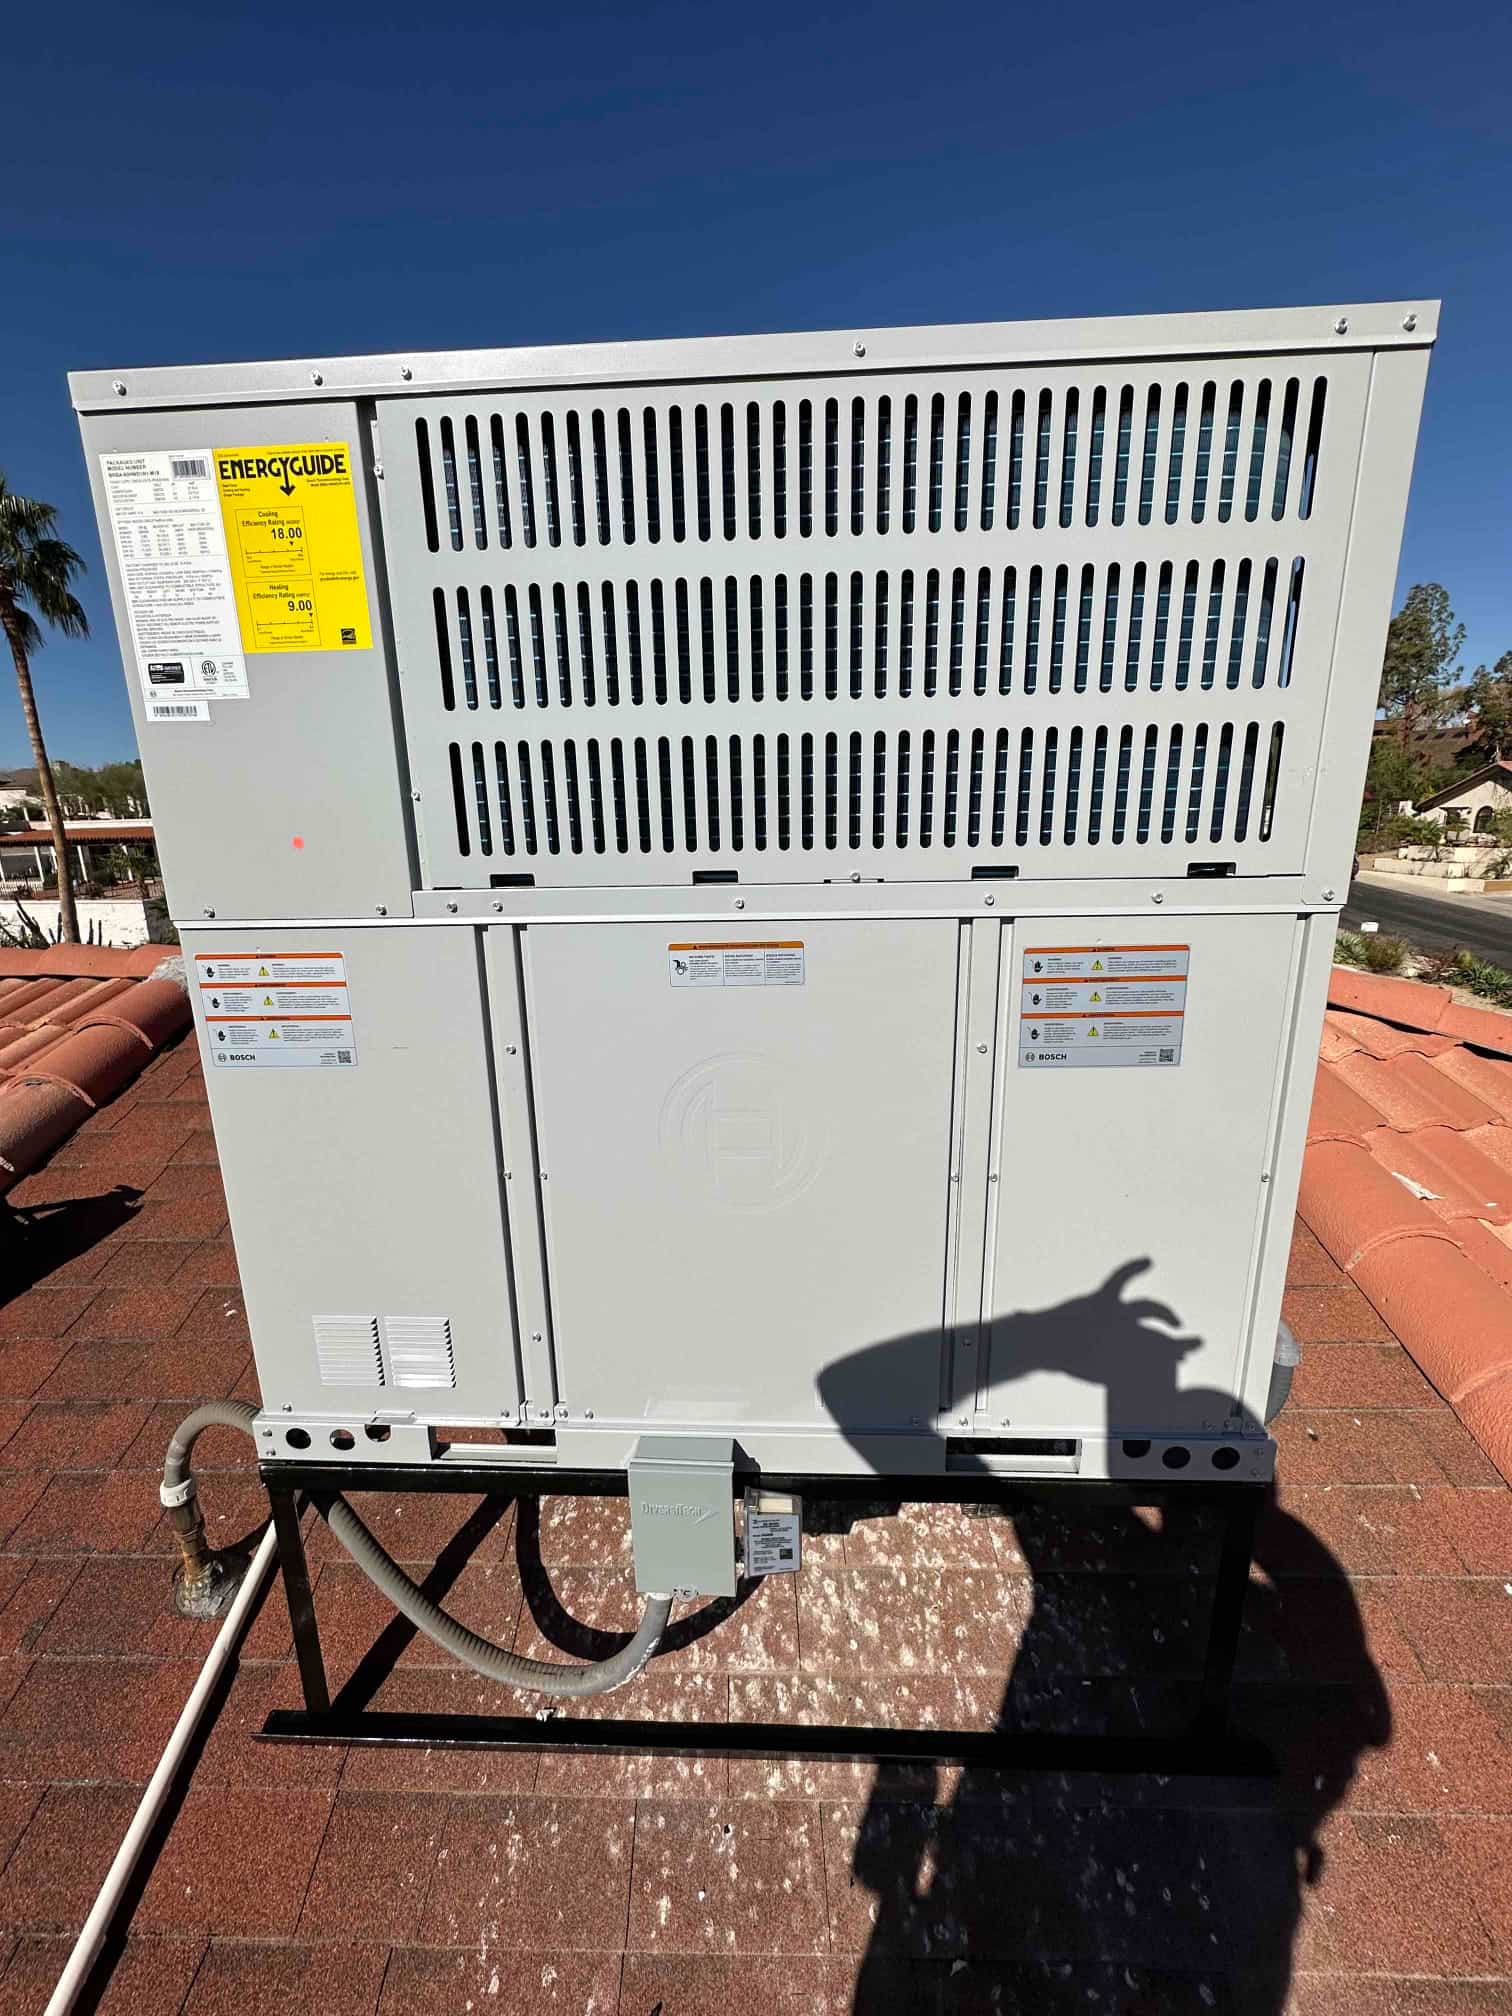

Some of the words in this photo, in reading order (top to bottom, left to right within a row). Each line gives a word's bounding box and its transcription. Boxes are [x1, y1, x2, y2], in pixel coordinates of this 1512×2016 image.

[218, 453, 347, 483] ENERGYGUIDE
[258, 510, 278, 518] Cooling
[241, 520, 267, 528] Efficiency
[268, 519, 285, 527] Rating
[271, 527, 302, 540] 18.00
[253, 592, 278, 600] Efficiency
[278, 591, 296, 599] Rating
[287, 600, 313, 612] 9.00
[1038, 1053, 1067, 1061] BOSCH
